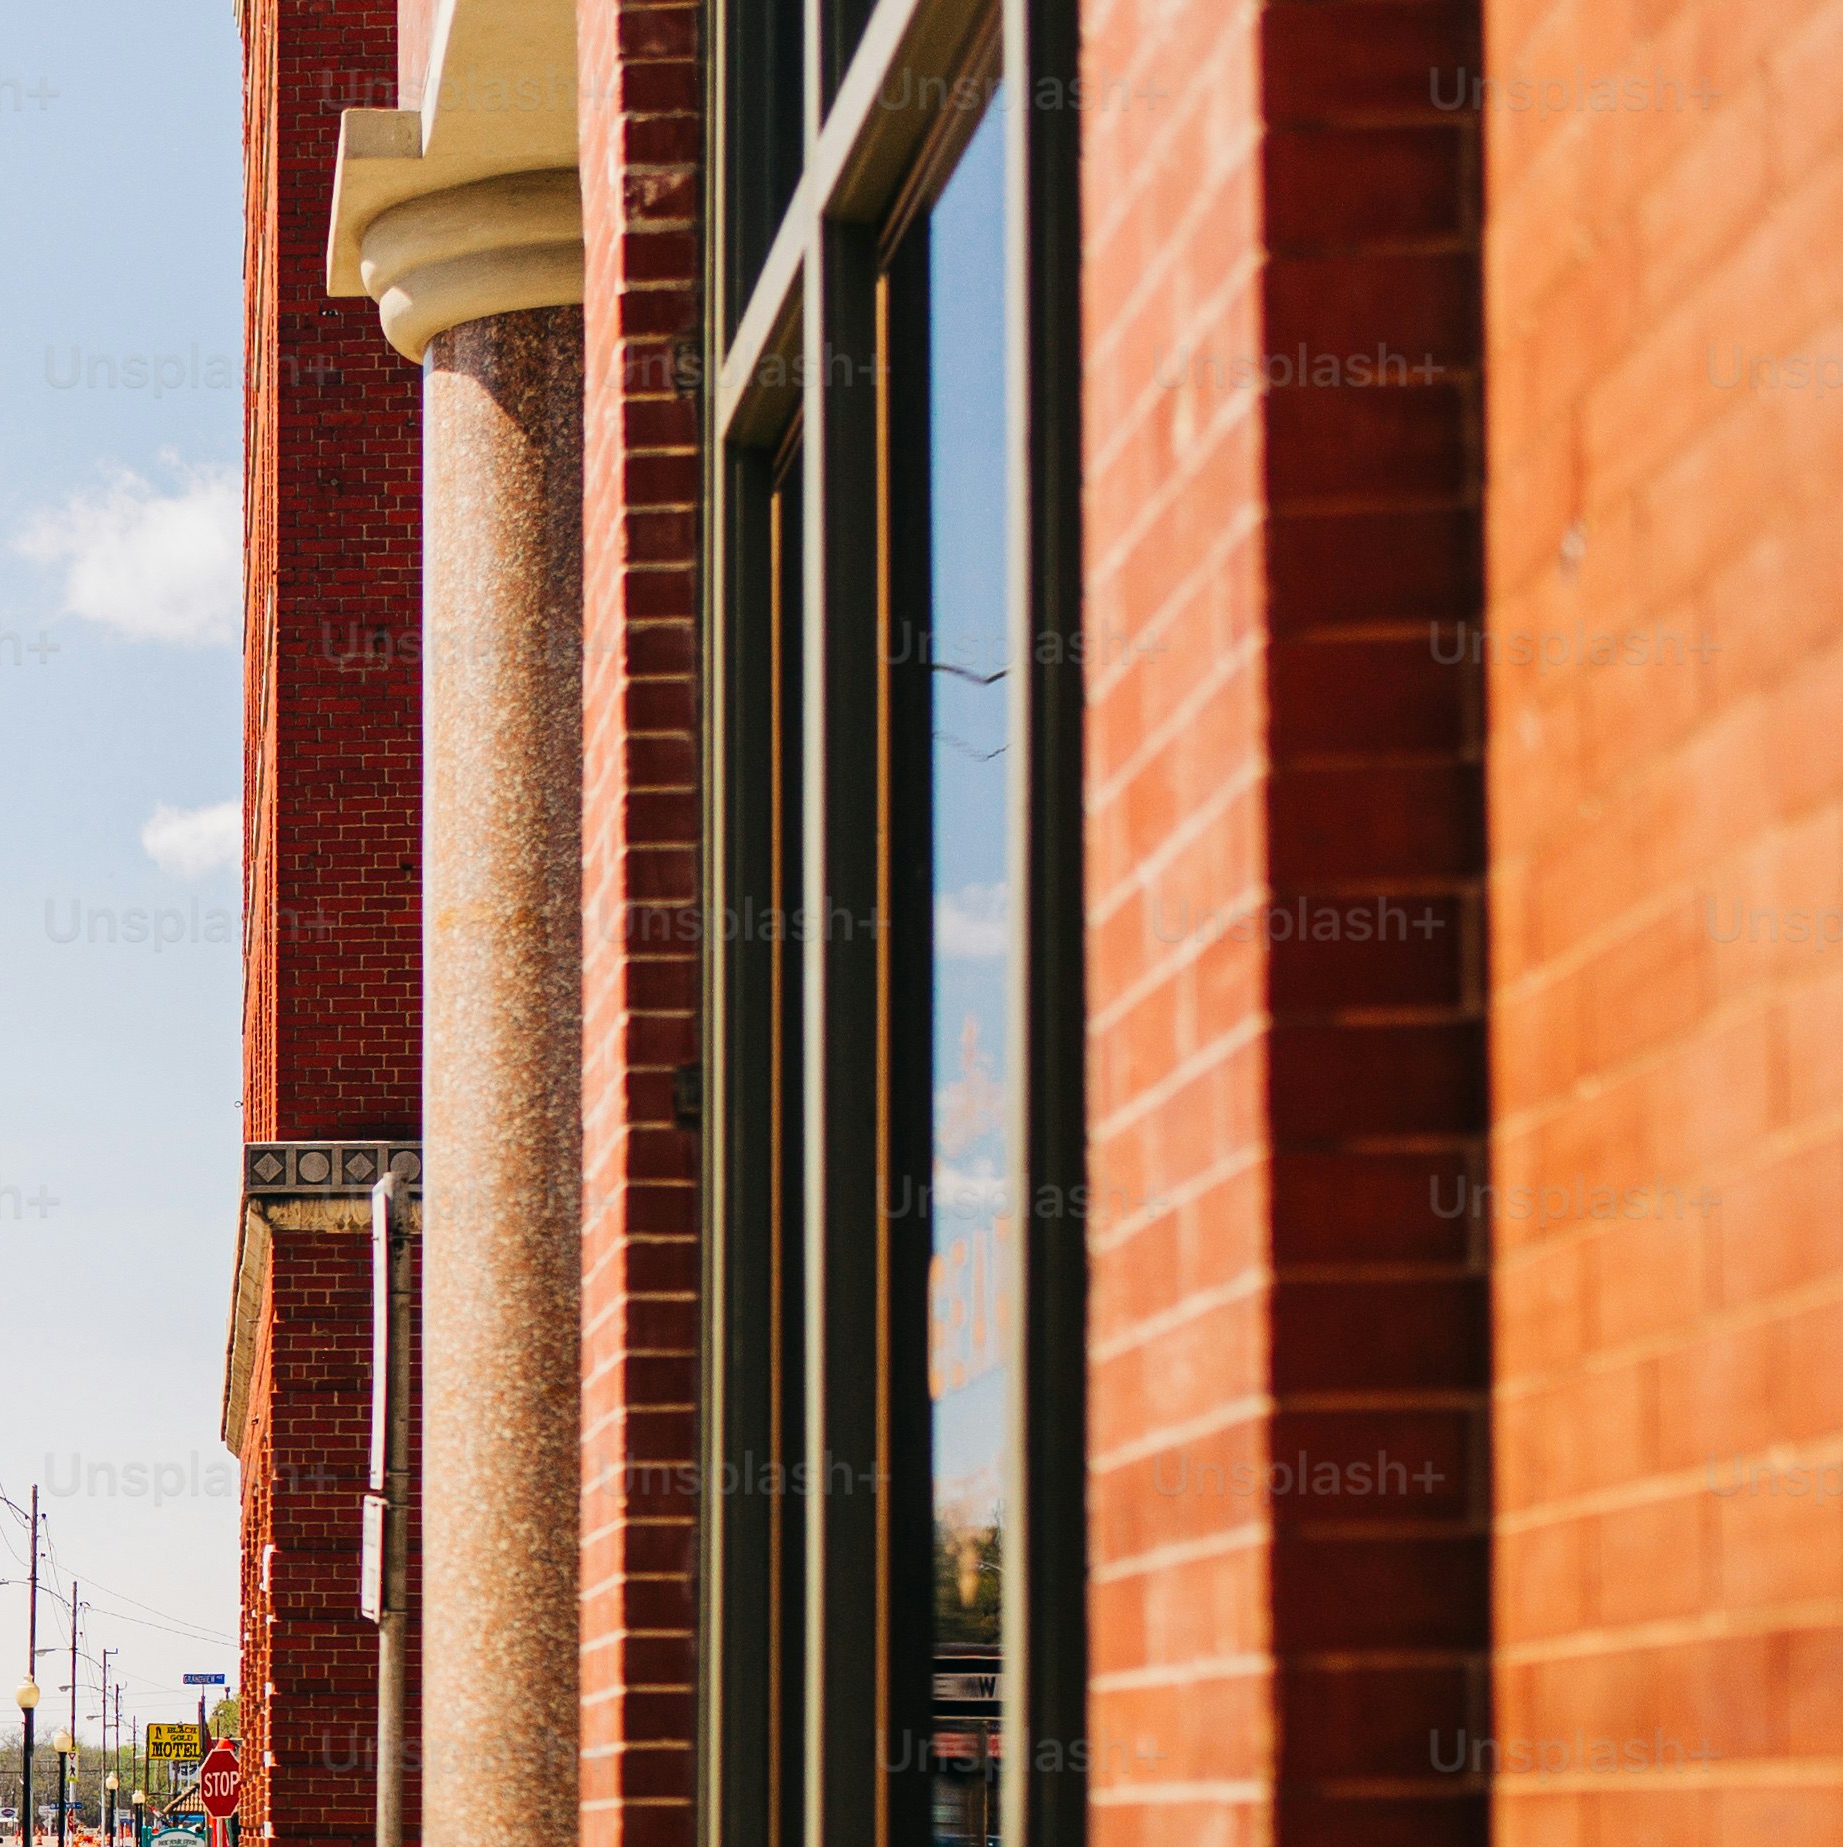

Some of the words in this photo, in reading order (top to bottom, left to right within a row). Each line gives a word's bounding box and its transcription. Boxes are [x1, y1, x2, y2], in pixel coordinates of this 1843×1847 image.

[166, 1726, 198, 1734] BLACK
[151, 1741, 201, 1758] MOTEL
[203, 1771, 240, 1797] STOP
